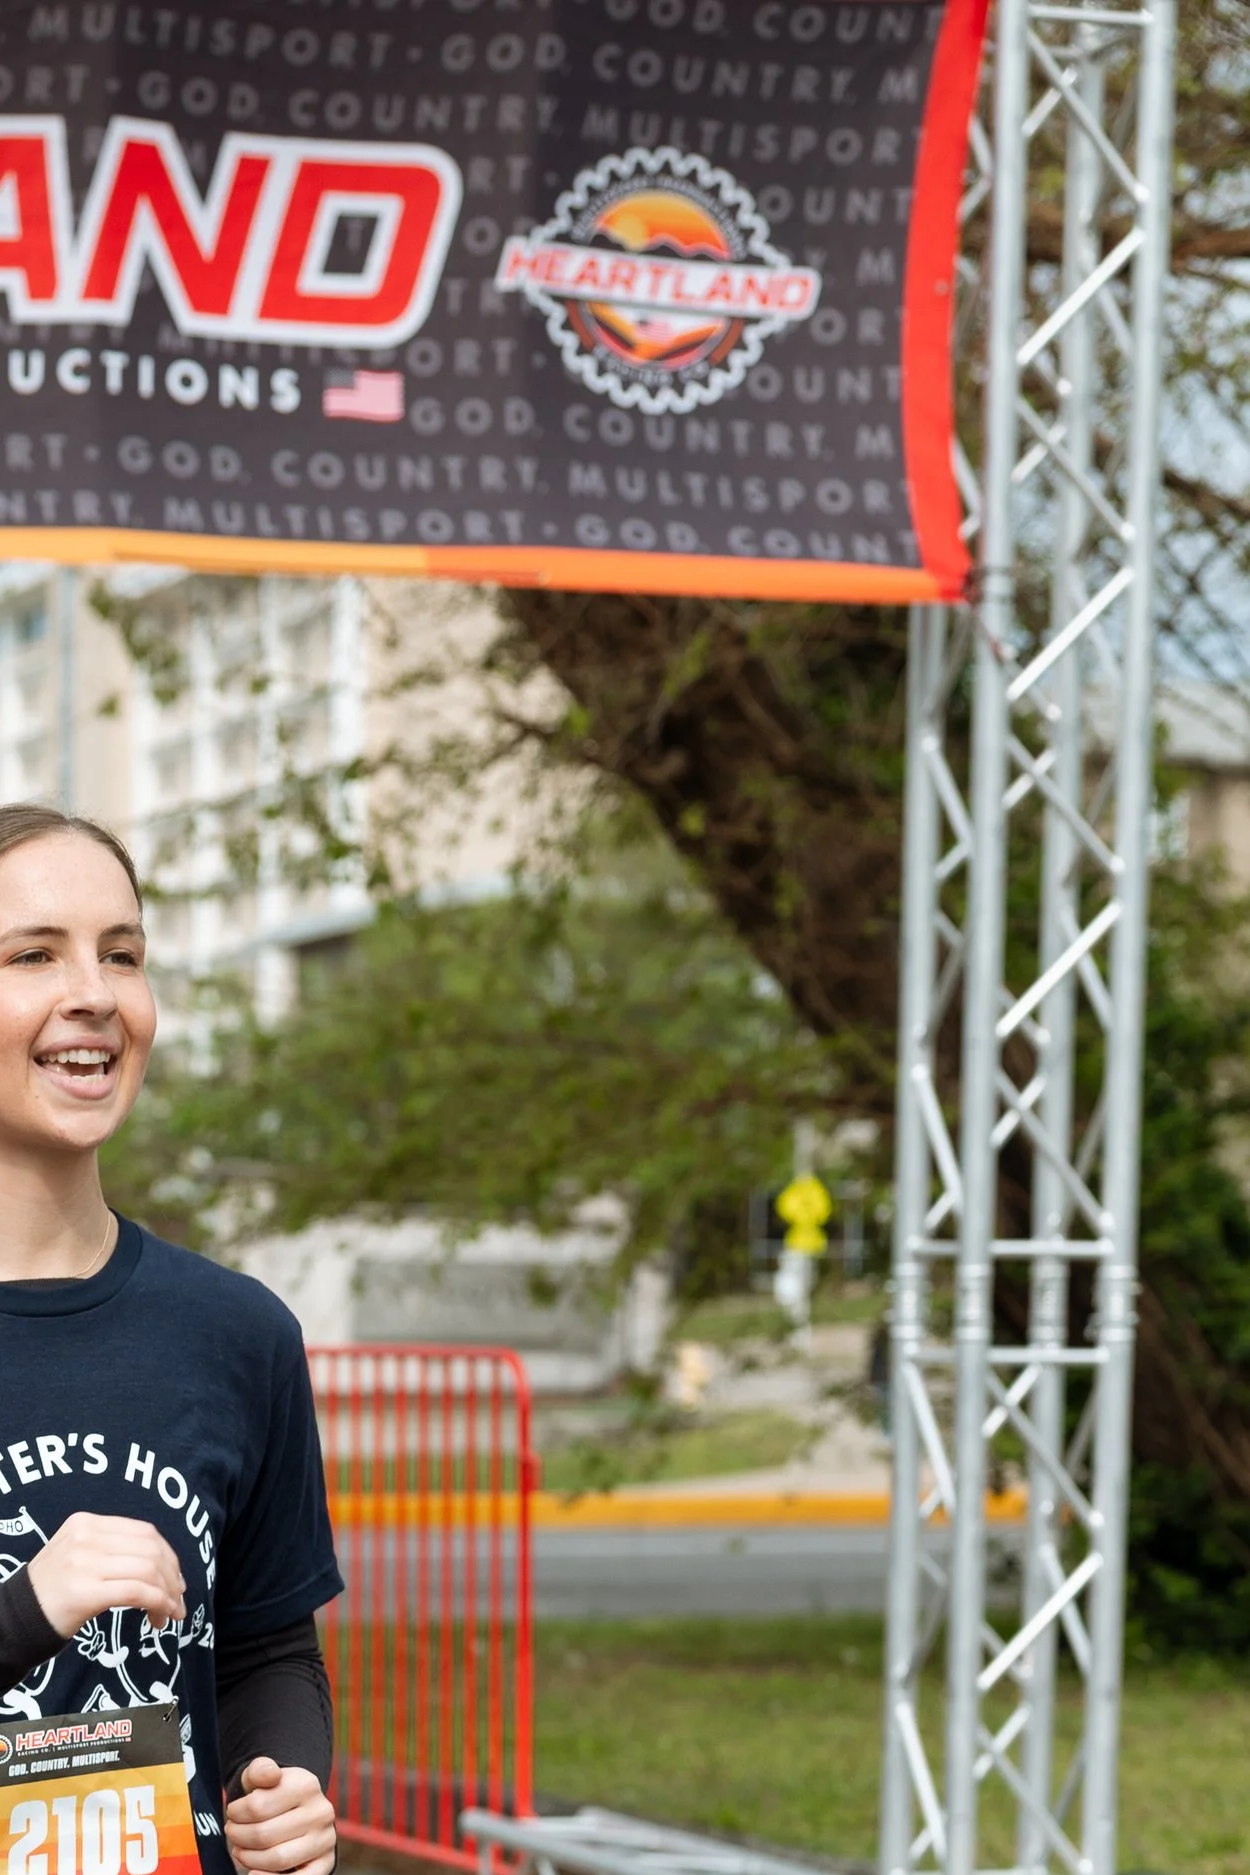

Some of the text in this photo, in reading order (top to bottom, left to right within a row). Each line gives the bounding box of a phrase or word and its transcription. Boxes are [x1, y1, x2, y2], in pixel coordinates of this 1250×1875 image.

[28, 3, 393, 68] MULTISPORT
[580, 104, 924, 165] MULTISPOR
[505, 246, 813, 312] HEARTLAND
[566, 462, 913, 515] MULTISPOR
[163, 497, 526, 544] MULTISPORT
[124, 1442, 217, 1590] HOUSE
[15, 1719, 133, 1752] HEARTLAND
[30, 1757, 70, 1774] COUNTRY.
[72, 1750, 121, 1768] MULTISPORT.
